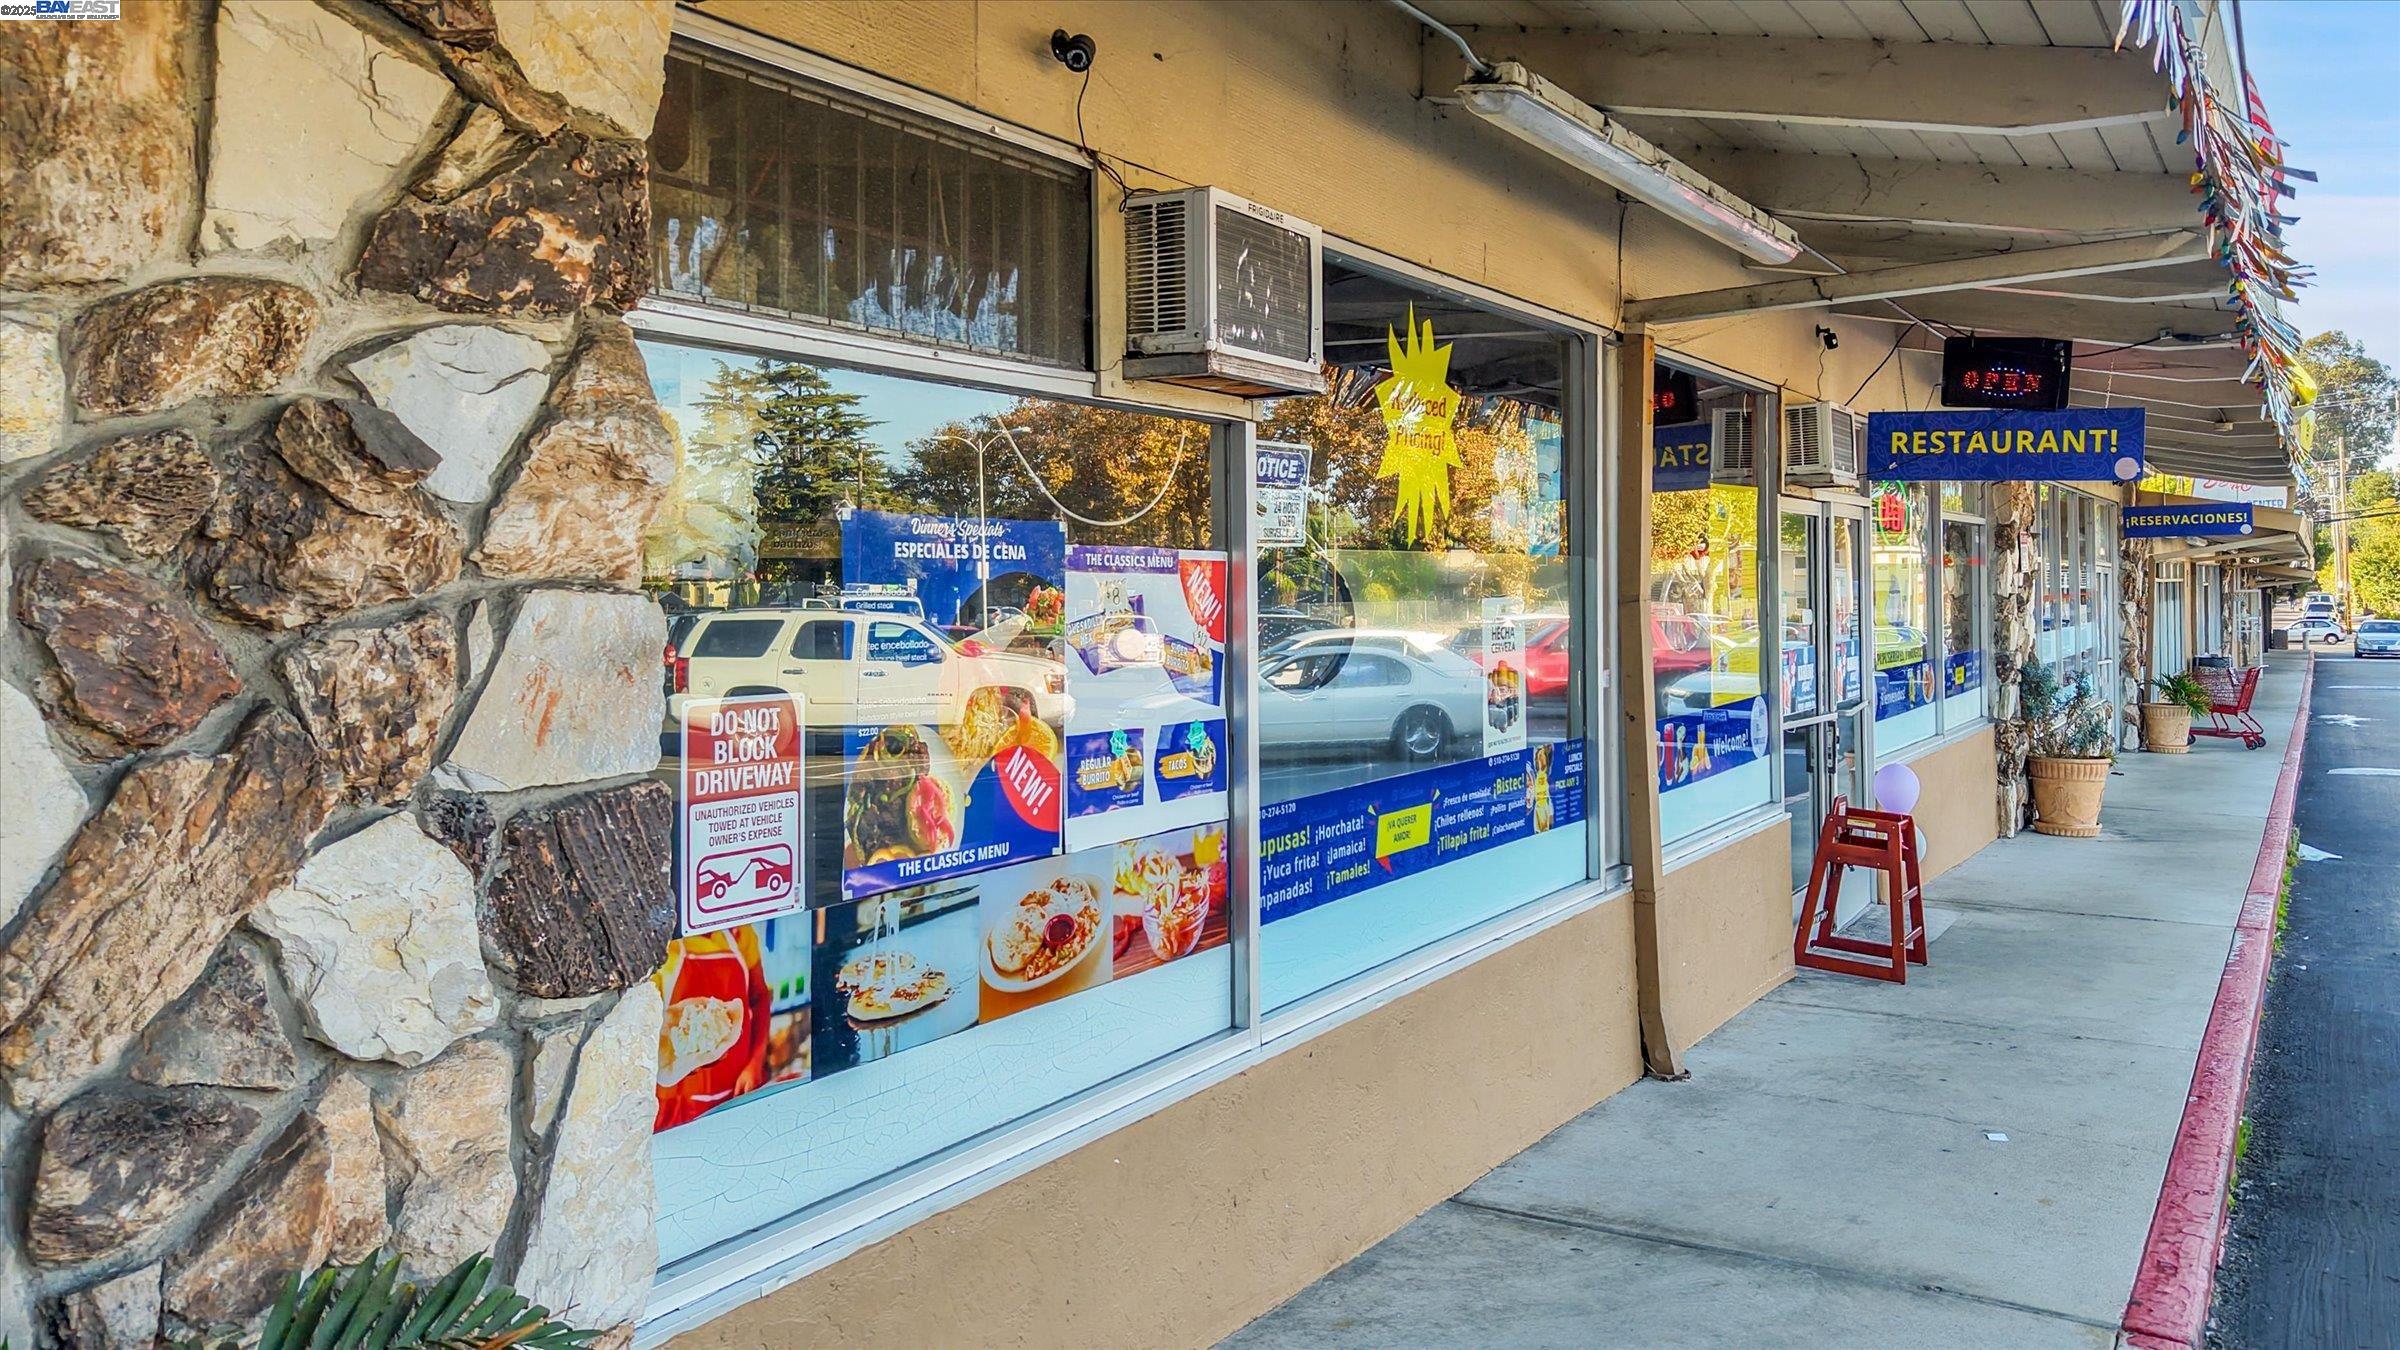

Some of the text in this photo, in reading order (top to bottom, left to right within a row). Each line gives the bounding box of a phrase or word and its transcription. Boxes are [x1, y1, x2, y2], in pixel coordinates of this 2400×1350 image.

[1248, 203, 1284, 224] FRIGIDAIRE
[1962, 370, 2042, 392] OPEN
[1890, 429, 2118, 454] RESTAURANT!
[1257, 456, 1299, 479] OTICE
[2126, 512, 2248, 529] ¡RESERVACIONES!
[894, 542, 1026, 560] ESPECIALES DE CENA
[1086, 553, 1174, 568] THE CLASSICS MENU
[856, 602, 876, 610] Grilled
[1187, 565, 1222, 627] NEW!
[1492, 626, 1516, 641] HECHA
[881, 640, 929, 651] encebollado
[1491, 641, 1516, 654] CERVEZA
[711, 708, 781, 736] DO NOT
[858, 727, 878, 737] $22.00
[714, 736, 778, 764] BLOCK
[1714, 728, 1749, 758] Welcome!
[1080, 756, 1112, 770] REGULAR
[1168, 758, 1188, 771] TACOS
[696, 761, 794, 796] DRIVEWAY
[1004, 746, 1054, 816] NEW!
[1082, 772, 1110, 786] BURRITO
[1494, 773, 1524, 799] ¡Bistec!
[1462, 793, 1468, 802] de
[695, 798, 794, 821] UNAUTHORIZED VEHICLES
[709, 812, 782, 833] TOWED AT VEHICLE
[709, 826, 782, 846] OWNER'S EXPENSE
[1260, 815, 1364, 862] upusas! ¡Horchata!
[1438, 823, 1490, 856] ¡Tilapia frita!
[898, 842, 1010, 878] THE CLASSICS MENU
[1328, 838, 1366, 864] ¡Jamaica!
[1263, 852, 1320, 886] ¡Yuca frita!
[1326, 860, 1370, 890] ¡Tamales!
[1260, 878, 1312, 911] mpanadas!
